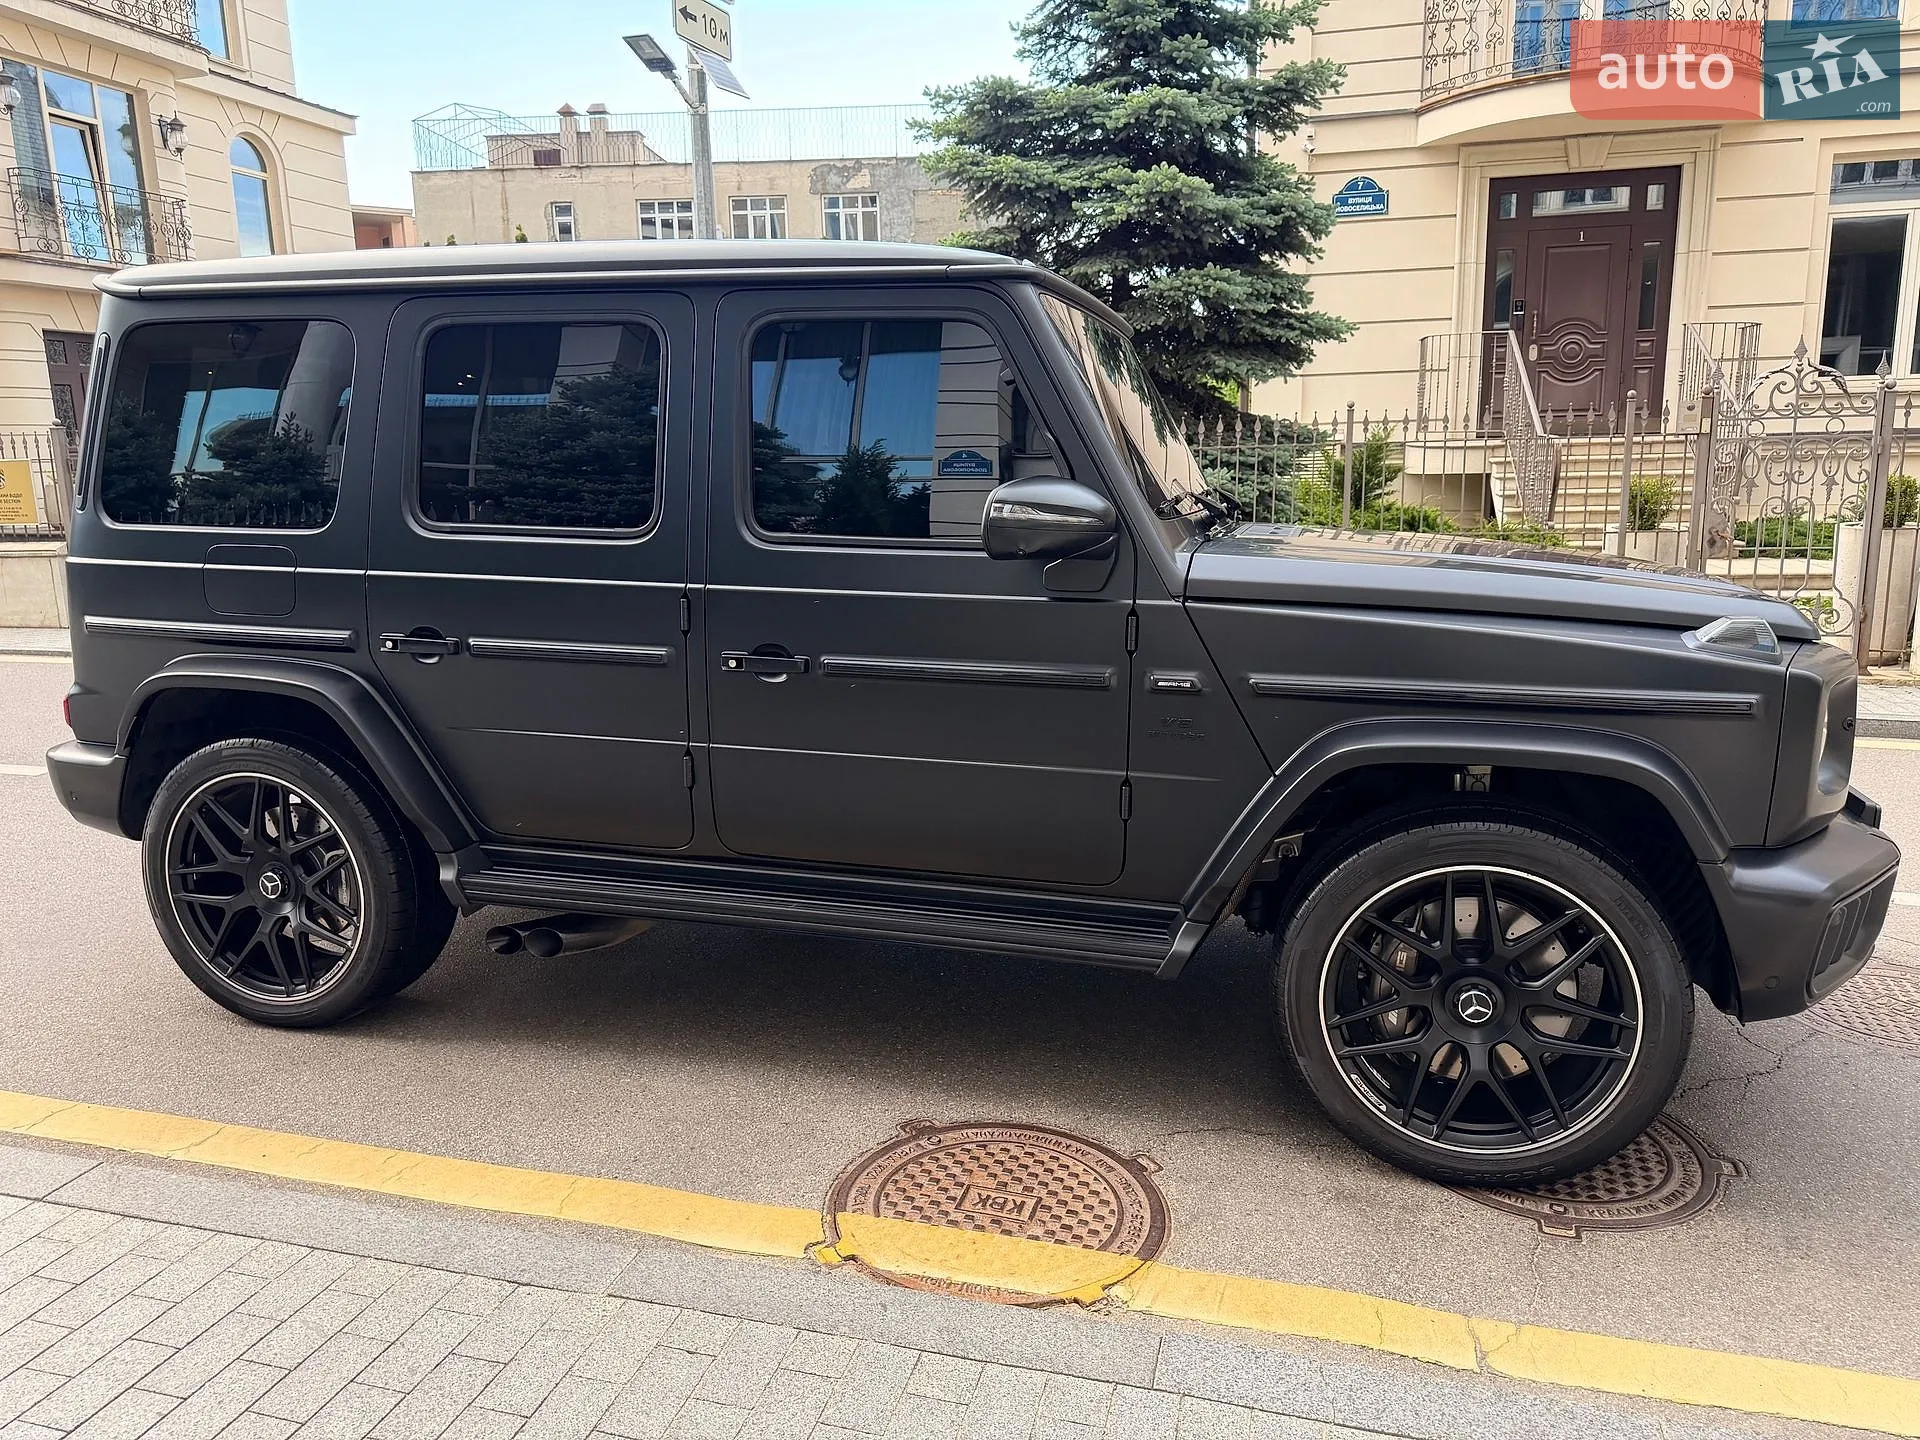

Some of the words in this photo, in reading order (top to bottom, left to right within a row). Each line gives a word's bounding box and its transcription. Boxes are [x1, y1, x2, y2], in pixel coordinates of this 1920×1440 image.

[1357, 181, 1364, 190] 7
[1347, 196, 1373, 205] ВУЛИЦЯ
[1579, 231, 1585, 242] 1
